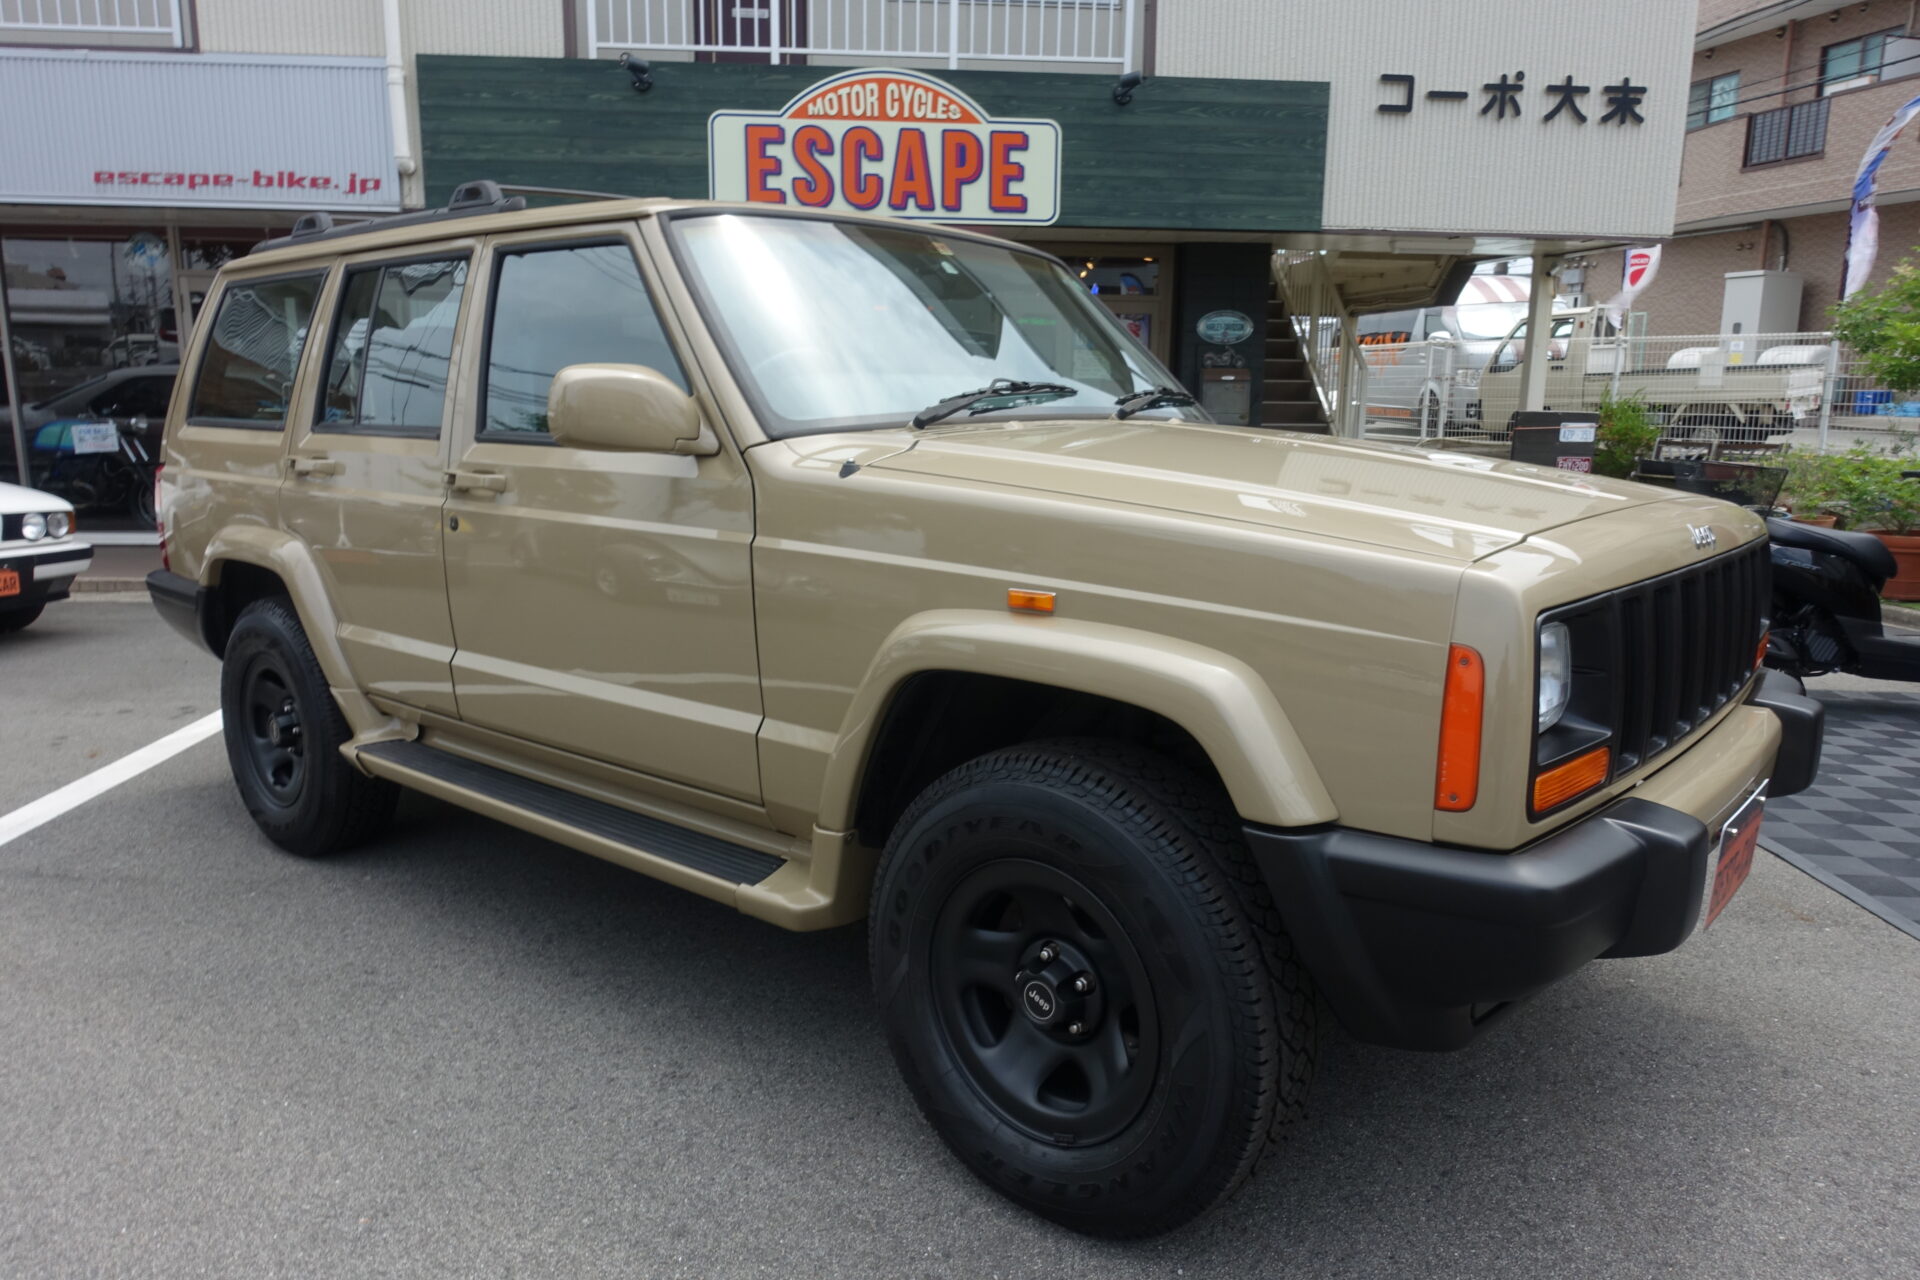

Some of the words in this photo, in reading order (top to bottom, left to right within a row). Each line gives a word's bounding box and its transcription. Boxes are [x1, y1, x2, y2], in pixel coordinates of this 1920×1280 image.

[807, 82, 879, 117] MOTOR
[885, 82, 962, 120] CYCLES
[1378, 70, 1648, 126] コーポ大末
[93, 169, 382, 195] escape-bike.jp
[745, 123, 1029, 213] ESCAPE
[1029, 990, 1050, 1011] Jeep
